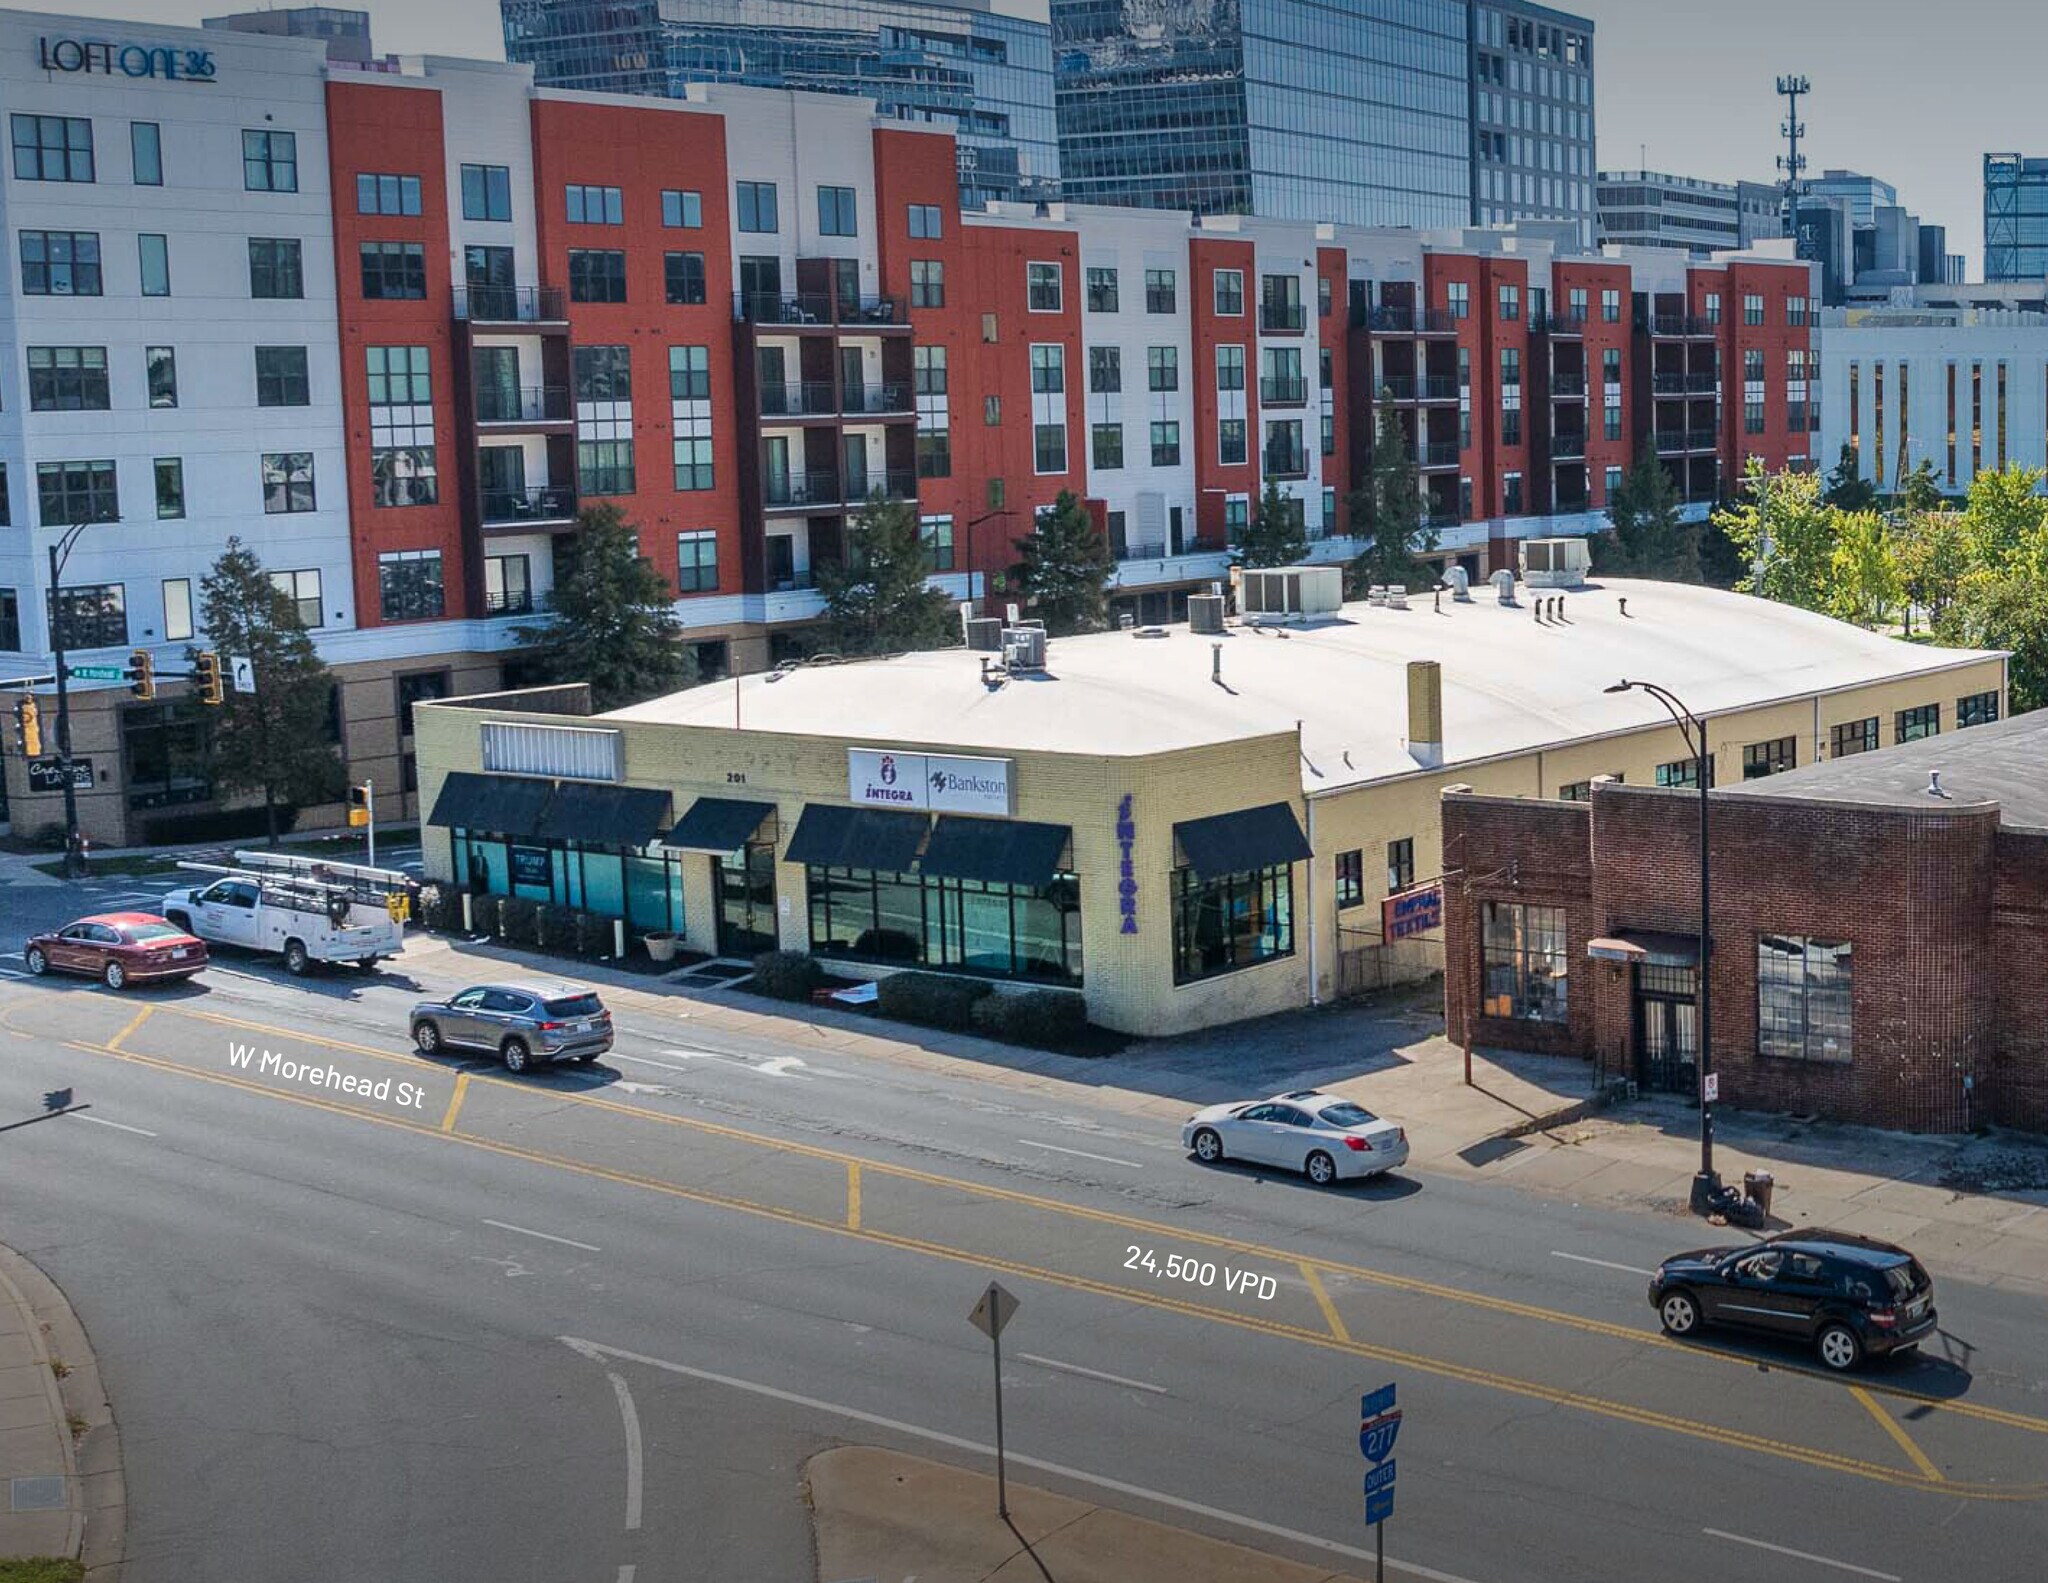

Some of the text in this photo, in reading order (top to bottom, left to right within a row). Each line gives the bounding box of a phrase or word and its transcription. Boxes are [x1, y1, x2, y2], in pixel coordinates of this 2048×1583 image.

[726, 773, 746, 783] 201
[949, 774, 1005, 795] Bankston
[1367, 1424, 1394, 1454] 277
[1366, 1464, 1394, 1489] OUTER
